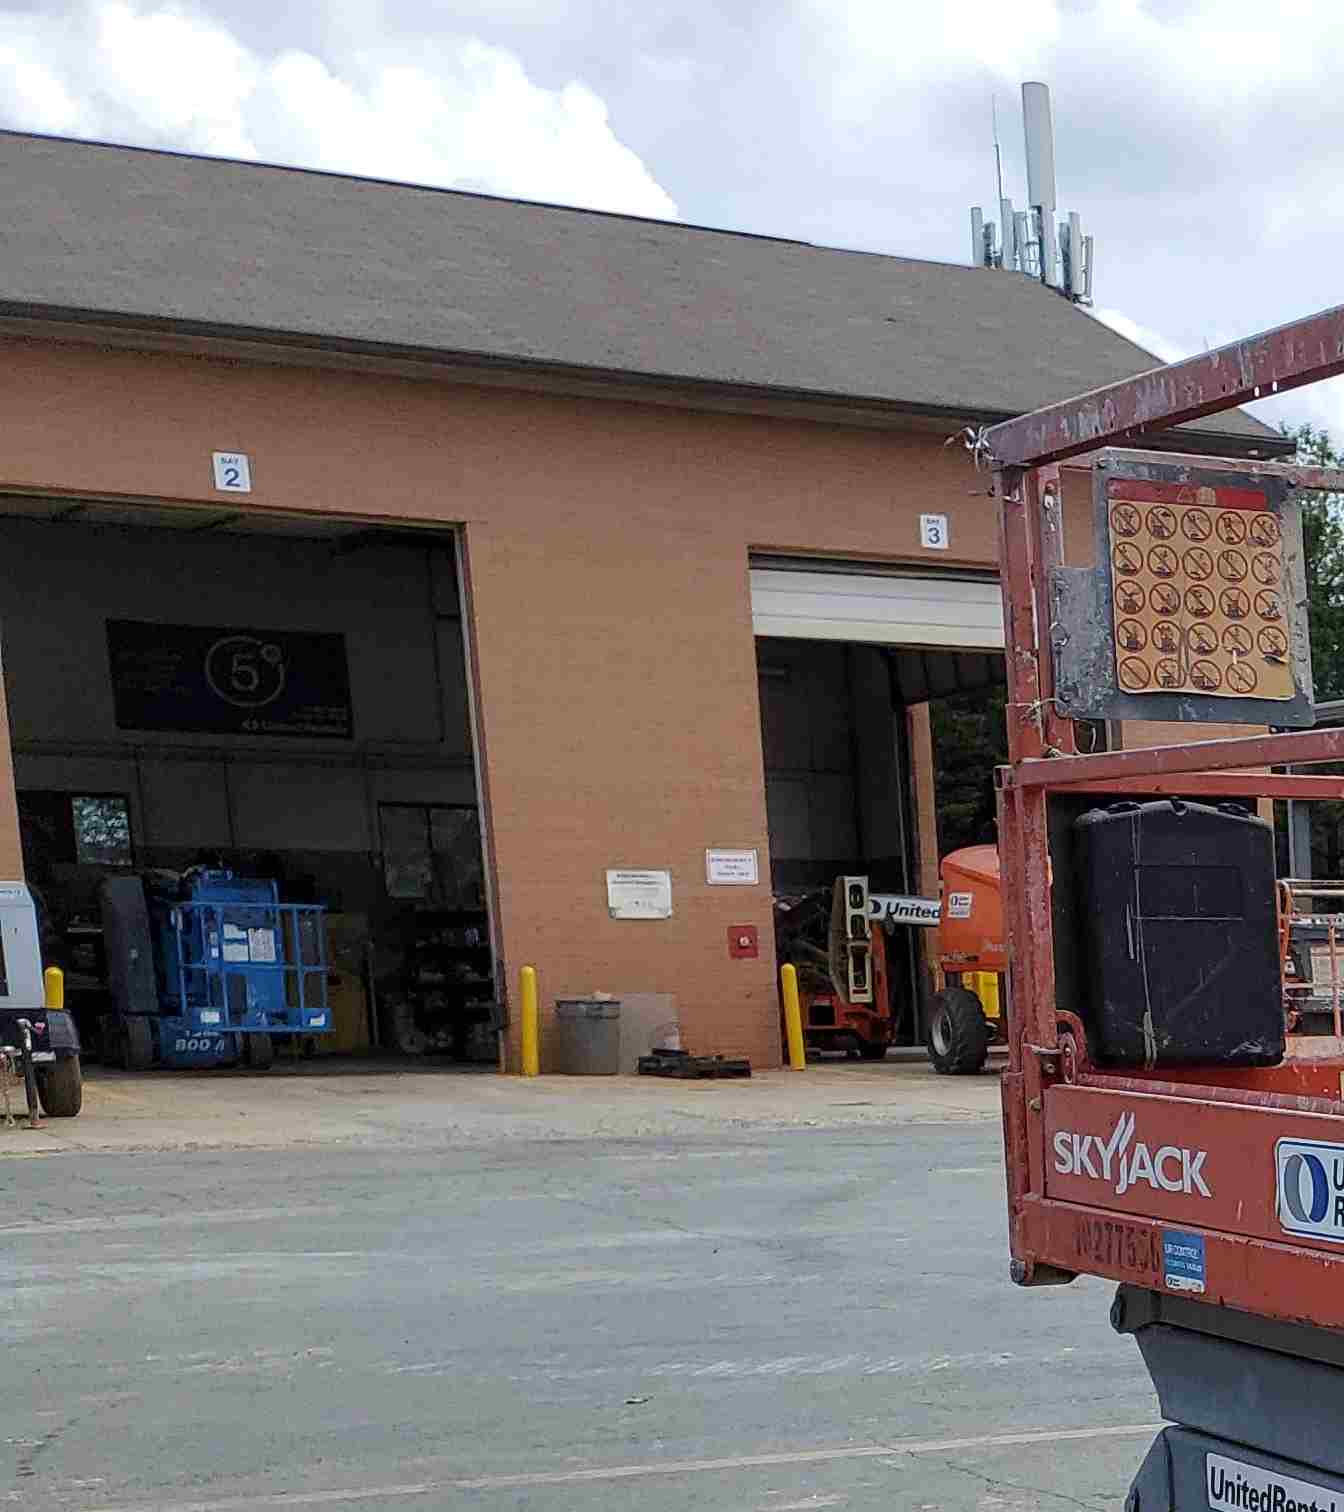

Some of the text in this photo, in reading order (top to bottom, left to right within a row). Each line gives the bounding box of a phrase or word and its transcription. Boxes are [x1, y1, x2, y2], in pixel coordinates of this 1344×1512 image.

[224, 468, 240, 487] 2
[928, 527, 940, 544] 3
[886, 901, 942, 919] United
[1053, 1112, 1211, 1199] SKYJACK
